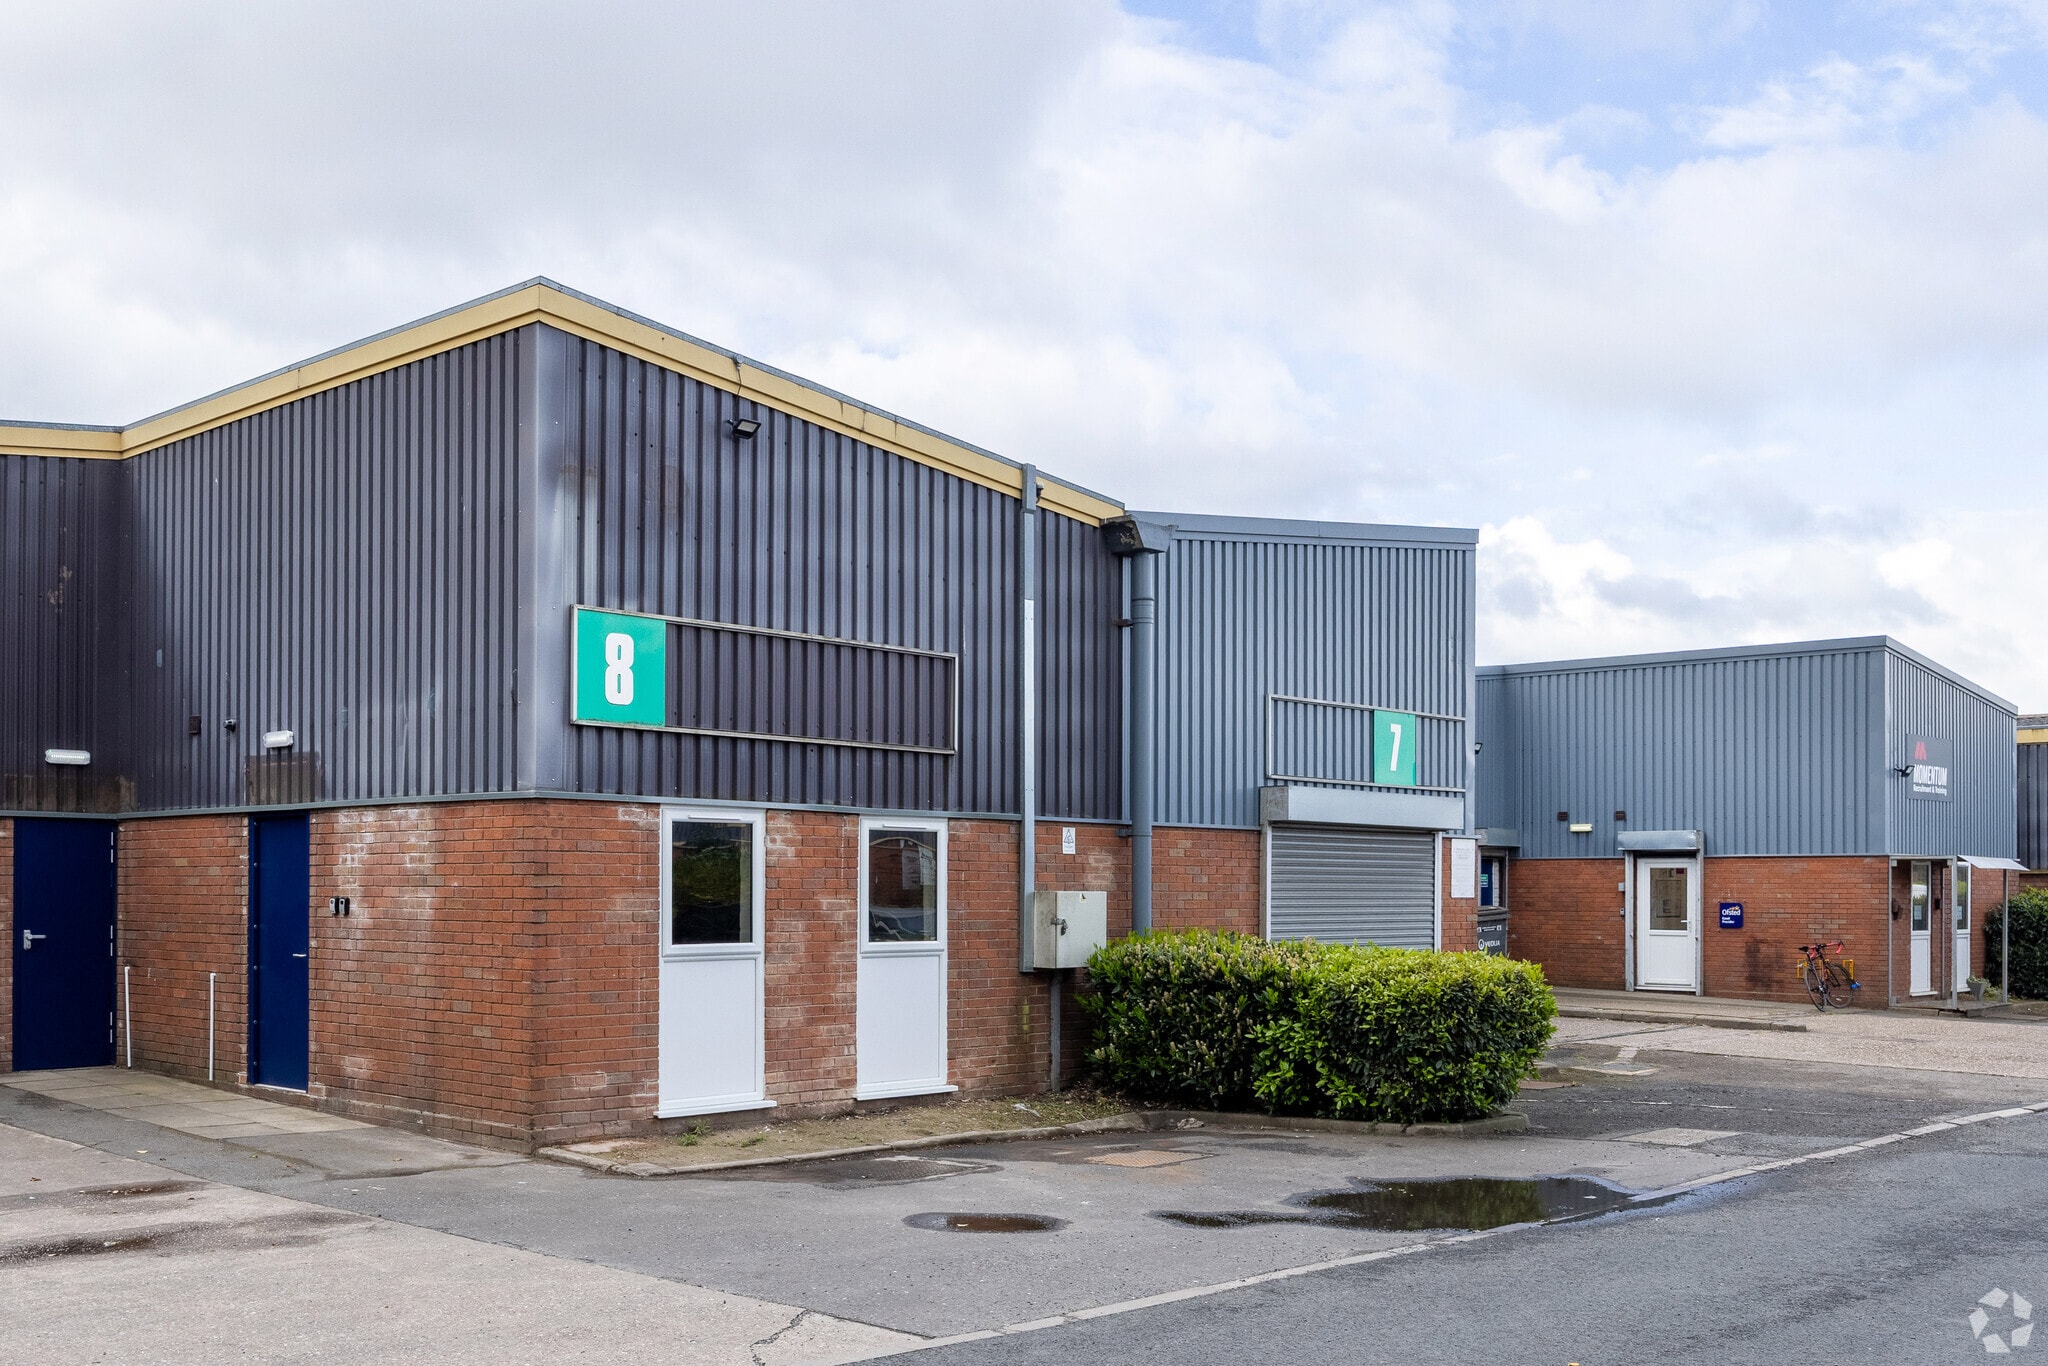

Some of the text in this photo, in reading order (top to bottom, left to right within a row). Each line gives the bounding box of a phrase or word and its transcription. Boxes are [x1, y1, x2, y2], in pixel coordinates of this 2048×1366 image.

[605, 632, 635, 706] 8
[1390, 723, 1402, 772] 7
[1913, 764, 1948, 786] MOMENTUM
[1721, 908, 1741, 916] Ofsted
